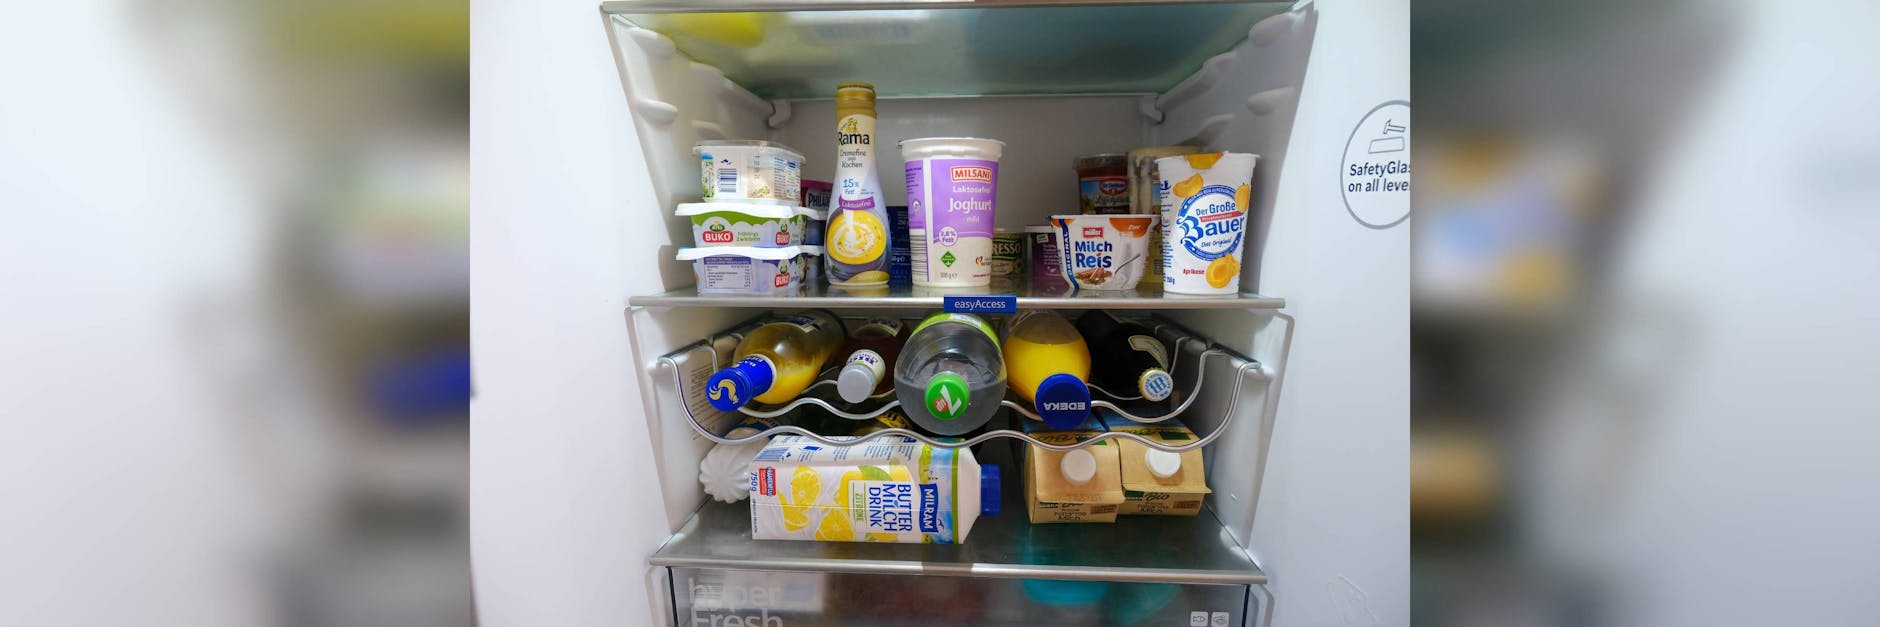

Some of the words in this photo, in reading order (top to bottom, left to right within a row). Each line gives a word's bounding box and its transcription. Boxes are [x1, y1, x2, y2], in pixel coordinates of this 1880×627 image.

[838, 132, 870, 146] Rama
[842, 161, 864, 169] Kochen
[954, 169, 992, 181] MILSANI
[1348, 182, 1362, 192] on
[1365, 178, 1380, 192] all
[1383, 177, 1410, 192] leve
[948, 197, 992, 214] Joghurt
[1196, 208, 1209, 216] Der
[1209, 201, 1236, 214] Große
[1176, 215, 1245, 244] Bauer
[705, 233, 731, 242] BUKO
[1075, 241, 1113, 253] Milch
[1076, 253, 1112, 269] Reis
[954, 300, 1006, 311] easyAccess
[1043, 402, 1086, 411] EDEKA
[868, 487, 882, 527] DRINK
[897, 484, 912, 532] BUTTER
[924, 488, 934, 529] MILRAM
